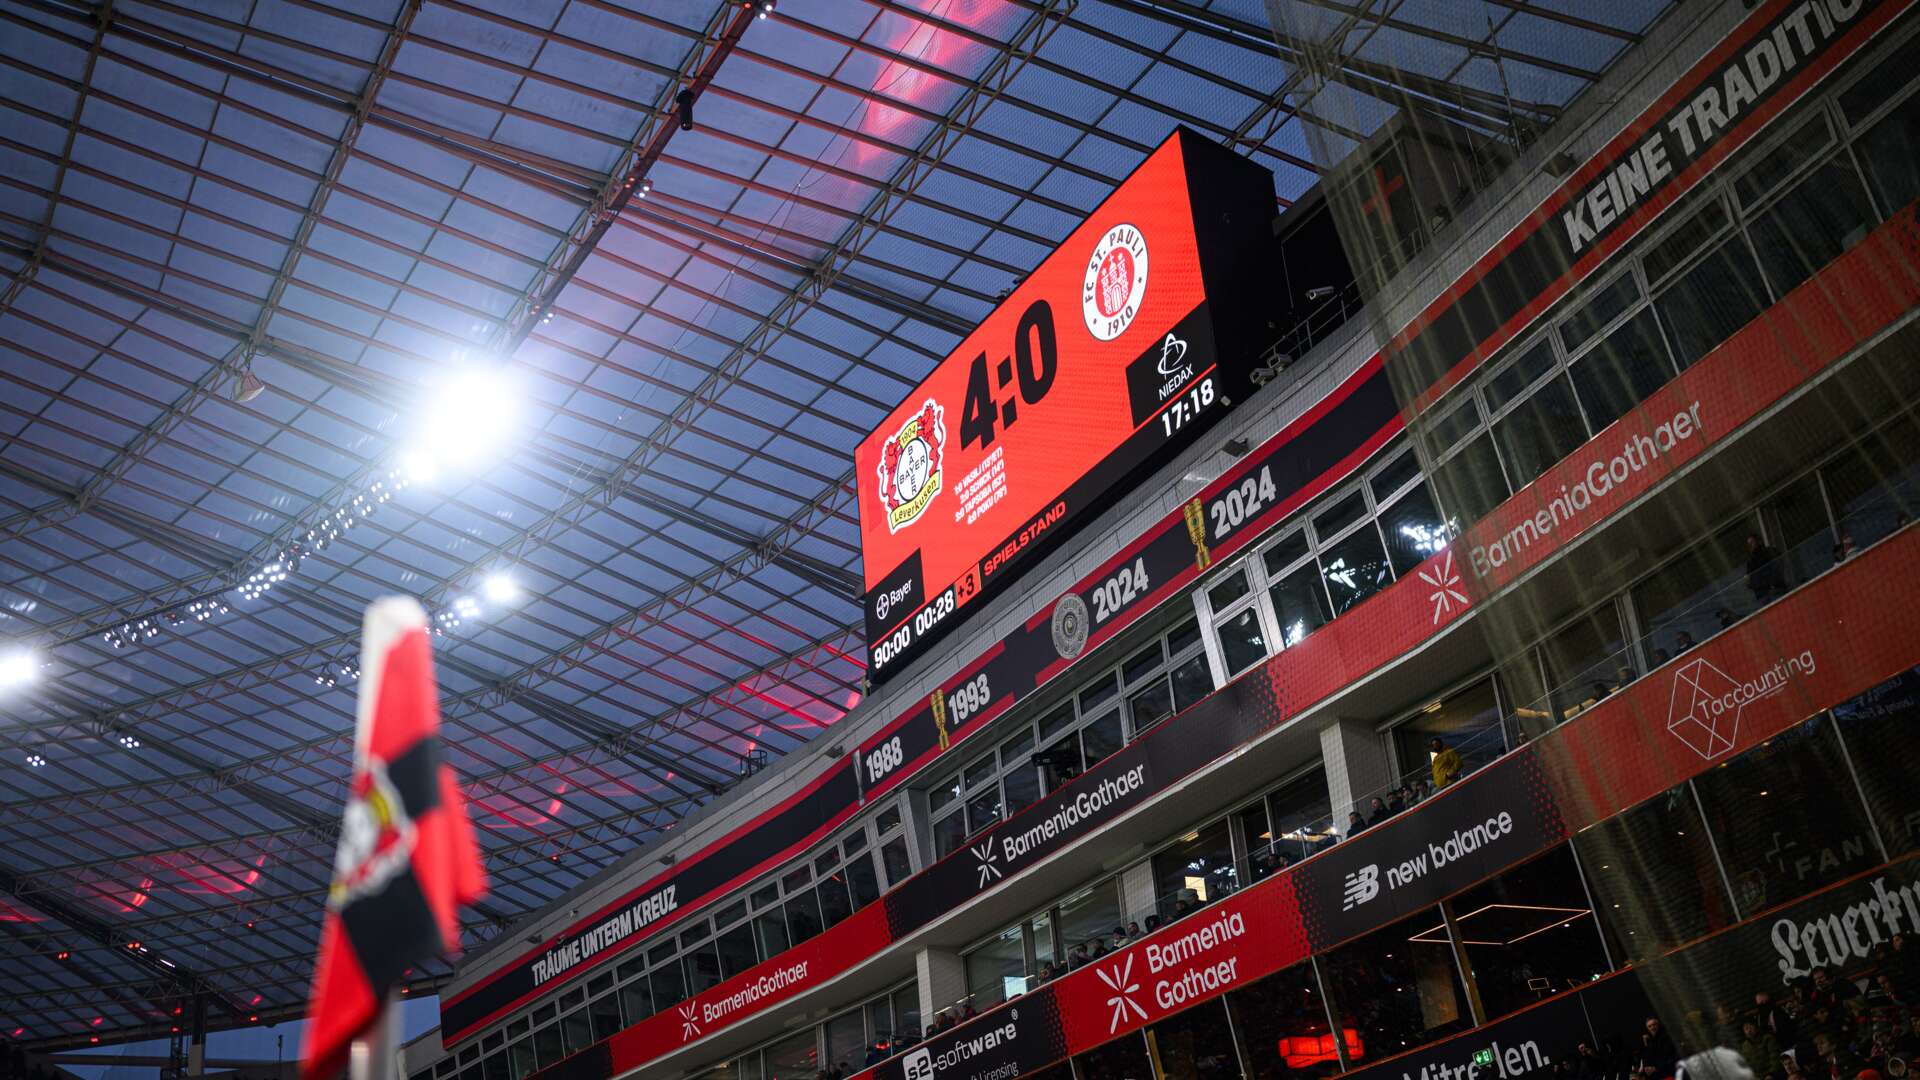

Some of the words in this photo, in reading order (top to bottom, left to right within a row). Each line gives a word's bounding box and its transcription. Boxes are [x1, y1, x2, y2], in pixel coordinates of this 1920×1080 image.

[1563, 131, 1672, 253] KEINE
[1109, 228, 1144, 259] PAULI
[1107, 305, 1133, 336] 1910
[960, 299, 1058, 451] 4:0
[1159, 363, 1193, 401] NIEDAX
[901, 424, 917, 444] 1904
[1162, 378, 1215, 437] 17:18
[894, 479, 937, 522] Leverkusen
[1211, 465, 1276, 540] 2024
[1468, 400, 1702, 578] BarmeniaGothaer
[874, 625, 911, 670] 90:00
[915, 589, 955, 637] 00:28
[958, 573, 975, 598] +3
[983, 501, 1067, 577] SPIELSTAND
[889, 579, 912, 606] Bayer
[1093, 557, 1149, 624] 2024
[948, 673, 991, 725] 1993
[1698, 649, 1816, 720] Taccounting
[866, 736, 903, 783] 1988
[1002, 764, 1144, 863] BarmeniaGothaer
[1386, 853, 1428, 890] new
[1428, 811, 1513, 869] balance
[531, 938, 581, 987] TRÄUME
[580, 909, 633, 960] UNTERM
[633, 884, 678, 931] KREUZ
[1146, 911, 1245, 974] Barmenia
[703, 960, 808, 1024] BarmeniaGothaer
[1156, 956, 1237, 1009] Gothaer
